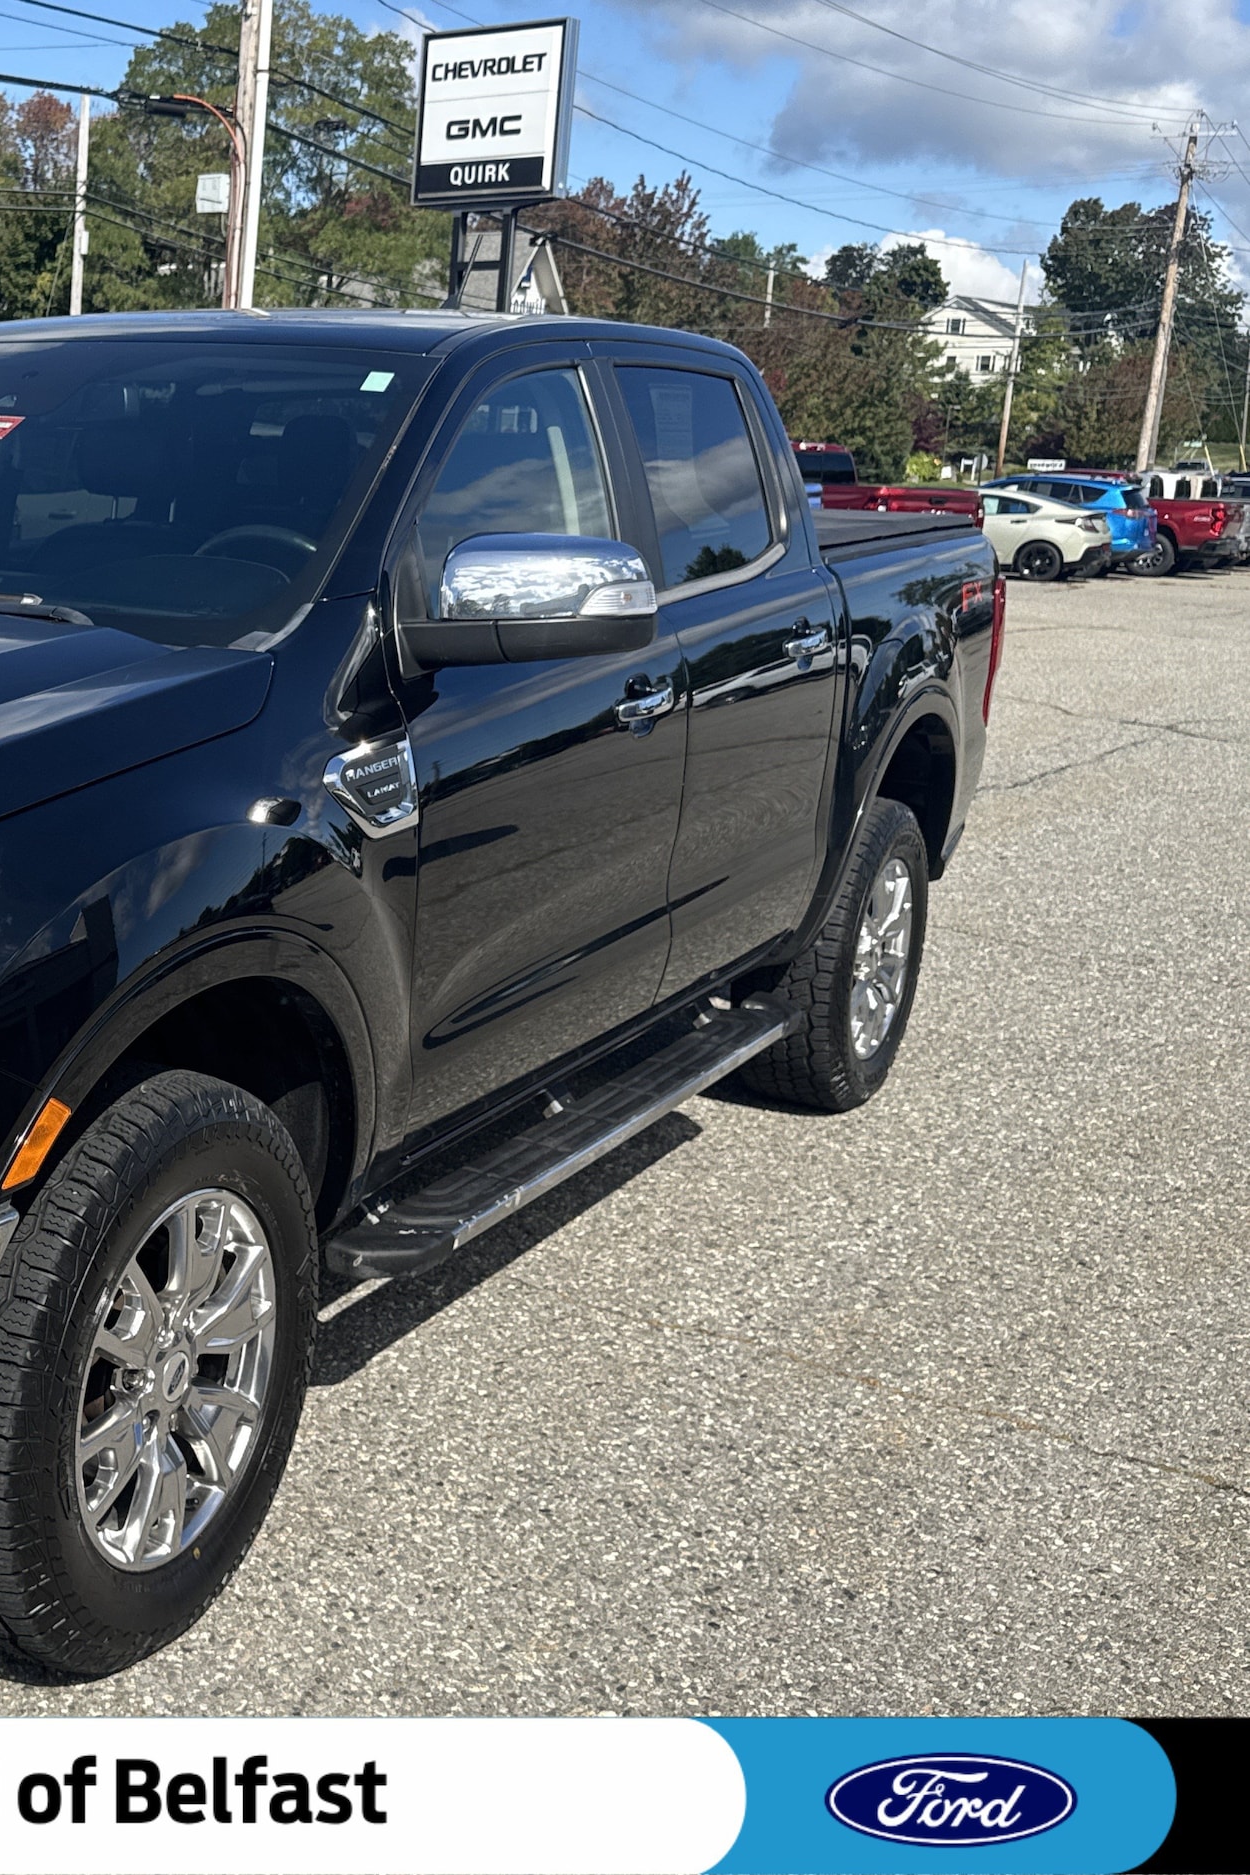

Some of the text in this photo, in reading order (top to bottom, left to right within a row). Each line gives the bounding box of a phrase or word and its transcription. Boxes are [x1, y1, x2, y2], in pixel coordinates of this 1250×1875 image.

[431, 52, 547, 82] CHEVROLET
[446, 114, 522, 141] GMC
[450, 162, 511, 187] QUIRK
[345, 755, 402, 782] RANGER
